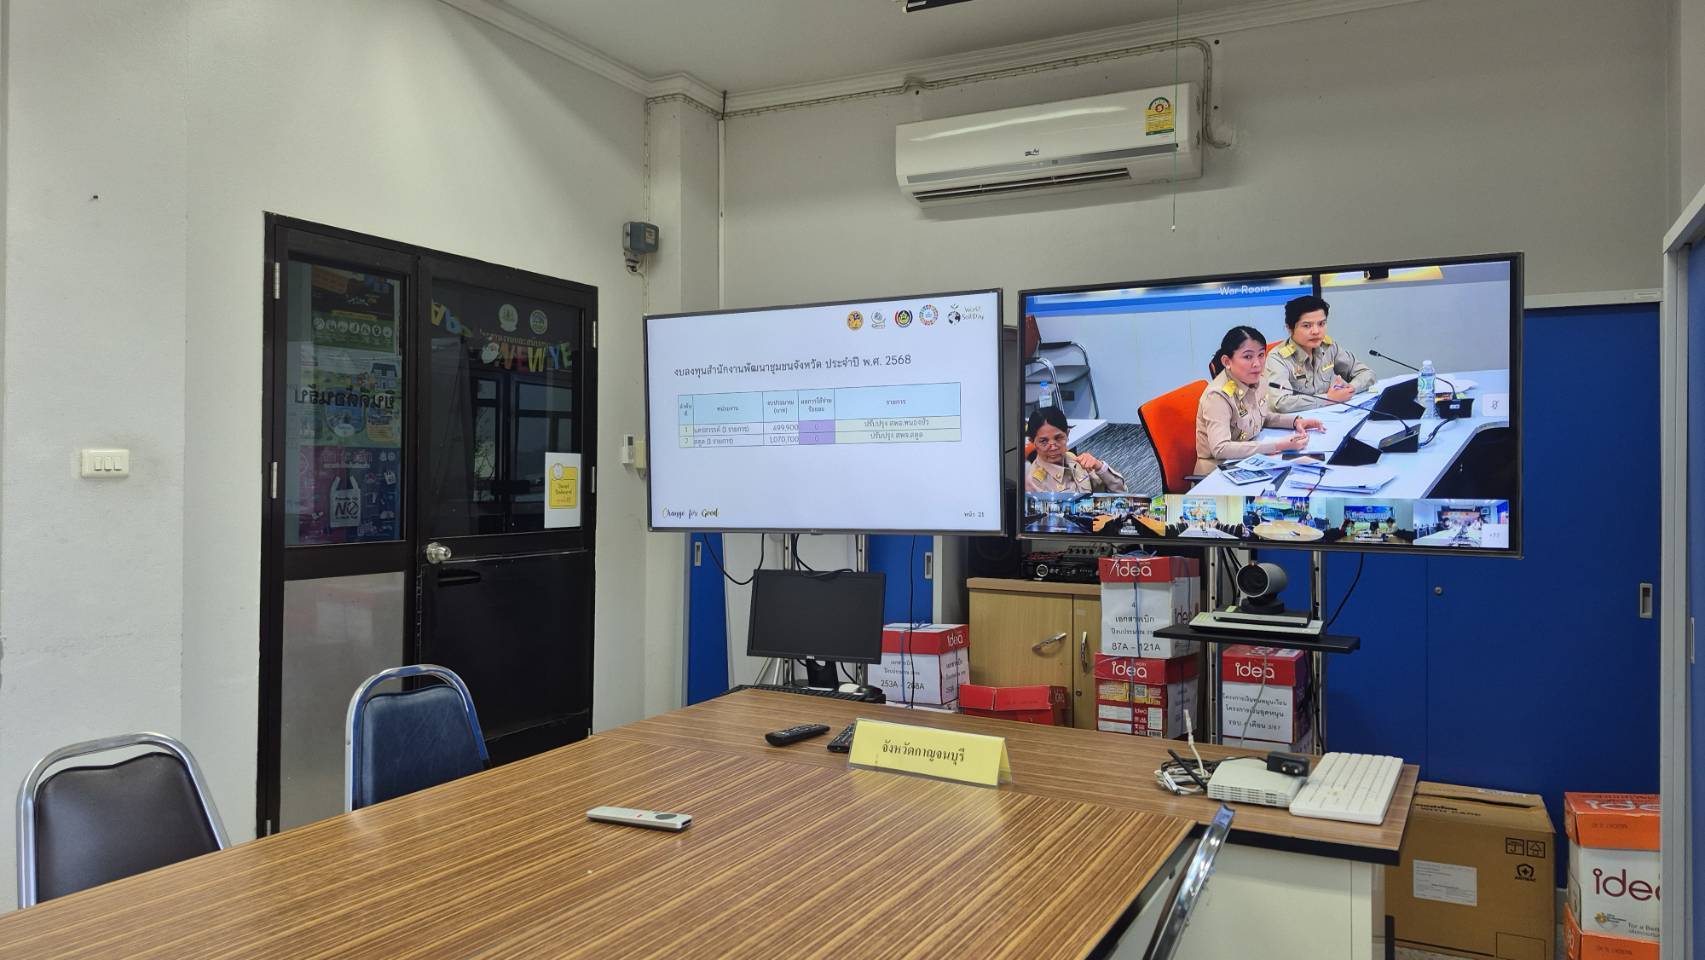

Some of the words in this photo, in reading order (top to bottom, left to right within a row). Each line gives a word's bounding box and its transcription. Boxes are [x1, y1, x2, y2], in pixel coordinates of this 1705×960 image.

[1219, 286, 1237, 296] War
[1241, 285, 1270, 295] Room
[825, 355, 860, 369] ประจำปี
[862, 356, 883, 368] พ.ศ.
[885, 354, 912, 366] 2568
[701, 508, 719, 518] Good
[1115, 562, 1152, 577] idea
[1111, 642, 1129, 651] 87A
[1138, 642, 1161, 651] 121A
[1111, 660, 1148, 679] idea
[1234, 661, 1276, 679] idea
[880, 679, 899, 689] 253A
[881, 739, 966, 766] จังหวัดกาญจนบุรี
